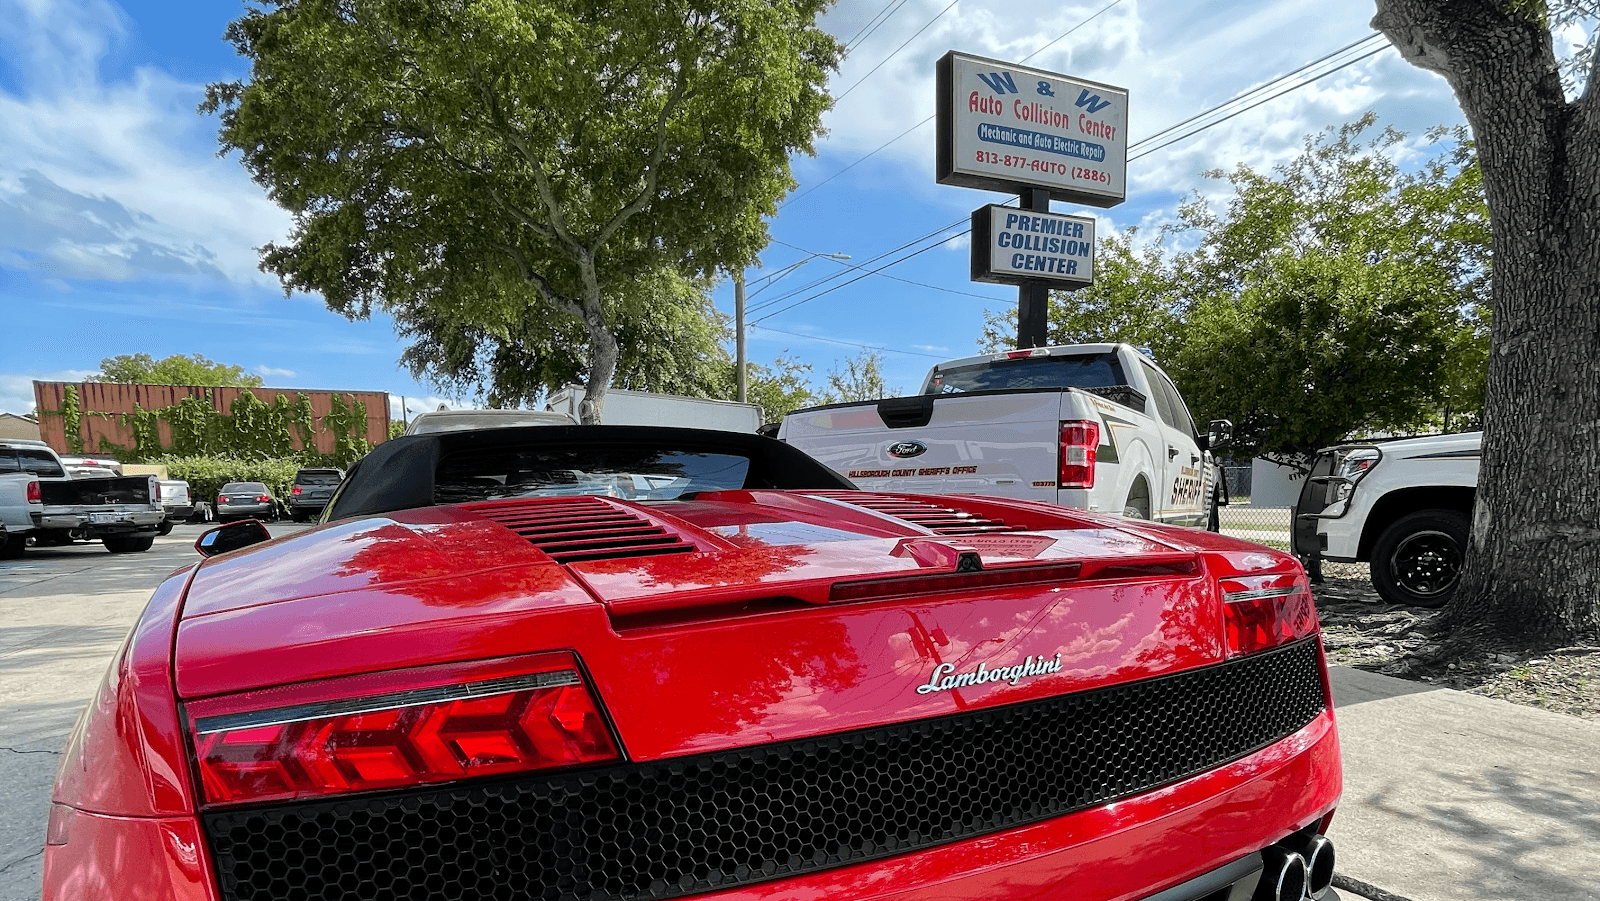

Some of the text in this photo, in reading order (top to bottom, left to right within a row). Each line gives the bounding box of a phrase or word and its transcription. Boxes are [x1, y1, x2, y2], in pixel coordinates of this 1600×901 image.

[976, 72, 1111, 114] W & W
[969, 91, 1117, 141] Auto Collision Center
[980, 124, 1103, 161] Mechanic and Auto Electric Repair
[976, 150, 1111, 186] 813-877-AUTO (2886)
[1006, 213, 1083, 239] PREMIER
[998, 231, 1090, 257] COLLISION
[1011, 253, 1077, 275] CENTER
[848, 465, 978, 478] HILLSBOROUGH COUNTY SHERIFF'S OFFICE
[1171, 477, 1202, 505] SHERIFF
[915, 652, 1063, 694] Lamborghini
